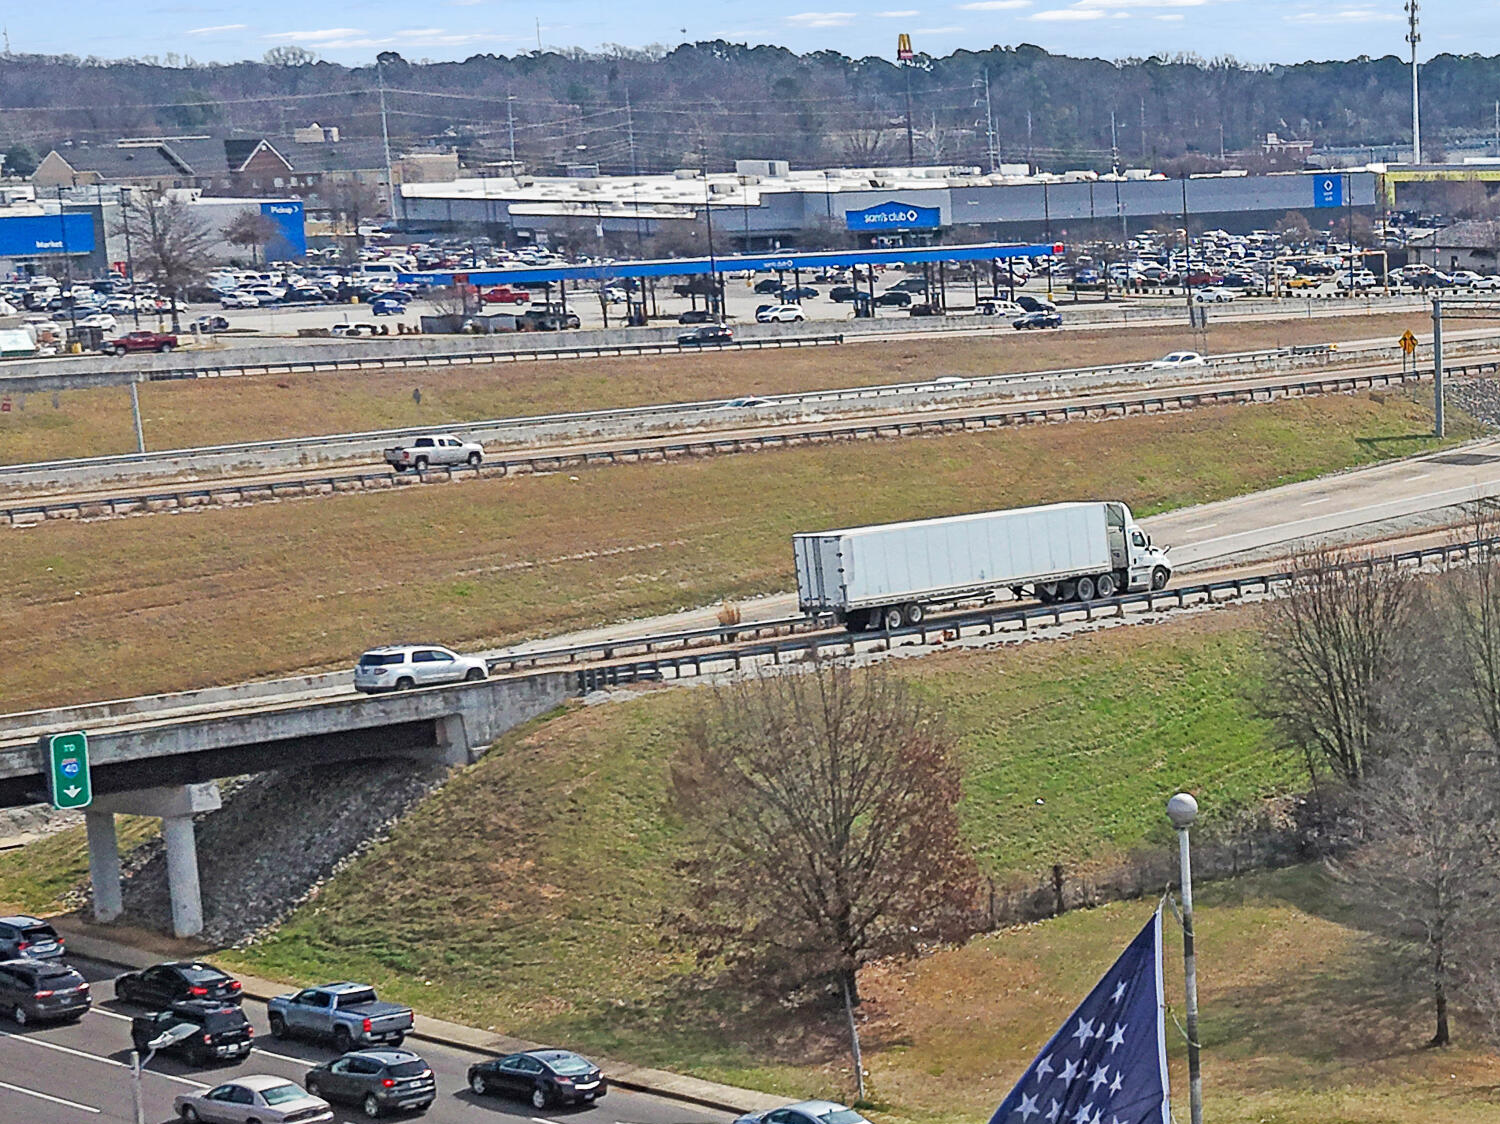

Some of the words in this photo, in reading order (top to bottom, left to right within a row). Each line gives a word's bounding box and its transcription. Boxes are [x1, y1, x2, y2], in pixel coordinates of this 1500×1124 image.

[864, 212, 888, 223] sam's
[888, 212, 906, 222] club
[64, 744, 76, 752] TO
[65, 763, 79, 773] 40
